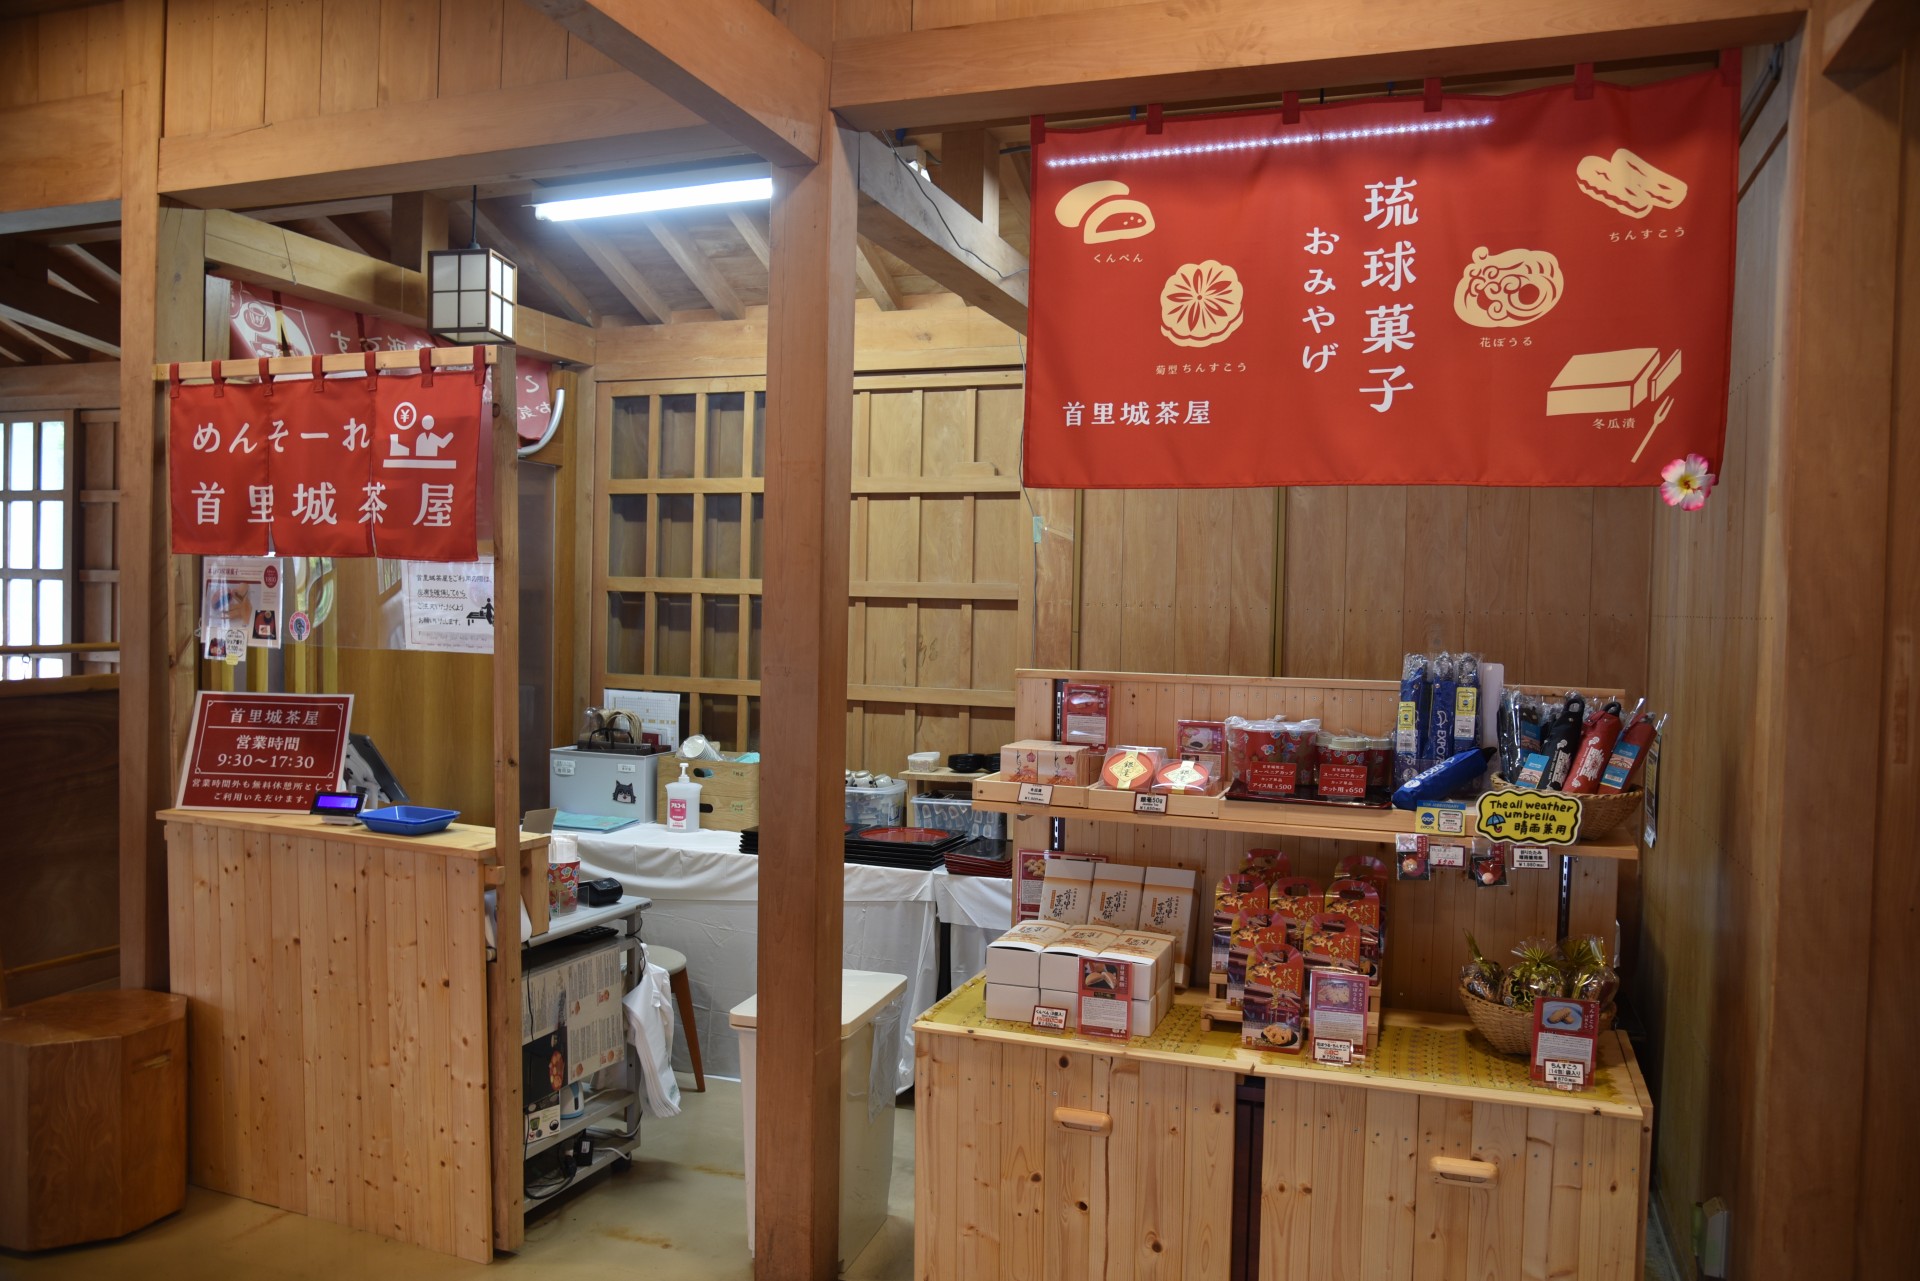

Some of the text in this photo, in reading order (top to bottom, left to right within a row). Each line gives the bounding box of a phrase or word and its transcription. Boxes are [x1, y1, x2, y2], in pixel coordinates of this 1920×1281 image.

[1608, 226, 1685, 243] ちんすこう
[1092, 252, 1144, 264] くんぺん
[1301, 226, 1340, 373] おみやげ
[1358, 176, 1419, 413] 琉球菓子
[1478, 335, 1534, 348] 花ぼうる
[1154, 361, 1248, 376] 菊型ちんすこう
[1062, 400, 1211, 427] 首里城茶屋
[1591, 416, 1636, 430] 冬瓜漬
[193, 418, 371, 454] めんそーれ
[191, 482, 455, 527] 首里城茶屋
[230, 708, 320, 726] 首里城茶屋
[236, 734, 300, 751] 営業時間
[192, 777, 334, 792] 営業時間外も無料休憩所として
[213, 792, 310, 805] ご利用いただけます。
[1489, 800, 1574, 812] The all weather
[1504, 810, 1557, 822] umbrella
[1514, 820, 1567, 835] 晴雨兼用
